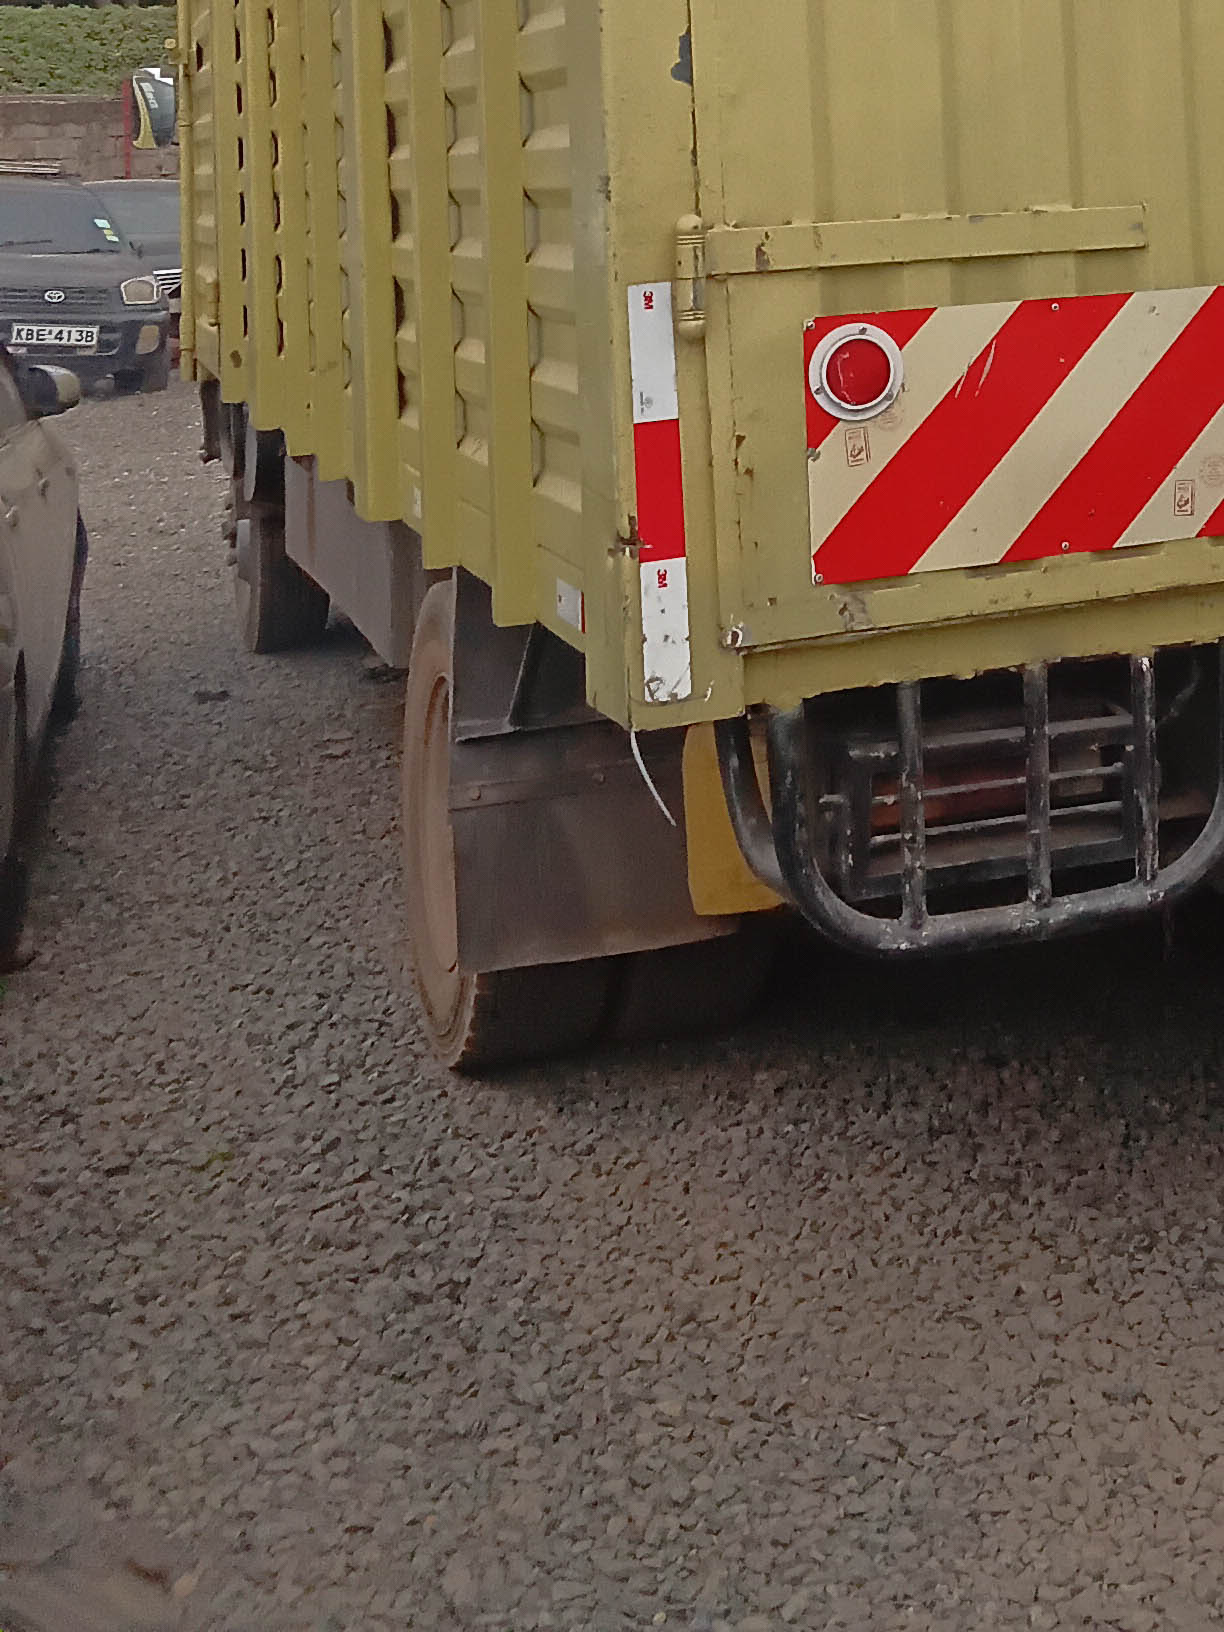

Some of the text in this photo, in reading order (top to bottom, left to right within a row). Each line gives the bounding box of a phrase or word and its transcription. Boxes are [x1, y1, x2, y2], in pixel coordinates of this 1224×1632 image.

[642, 290, 654, 310] 3M
[14, 327, 95, 343] KBE 413B
[656, 568, 668, 589] 3M
